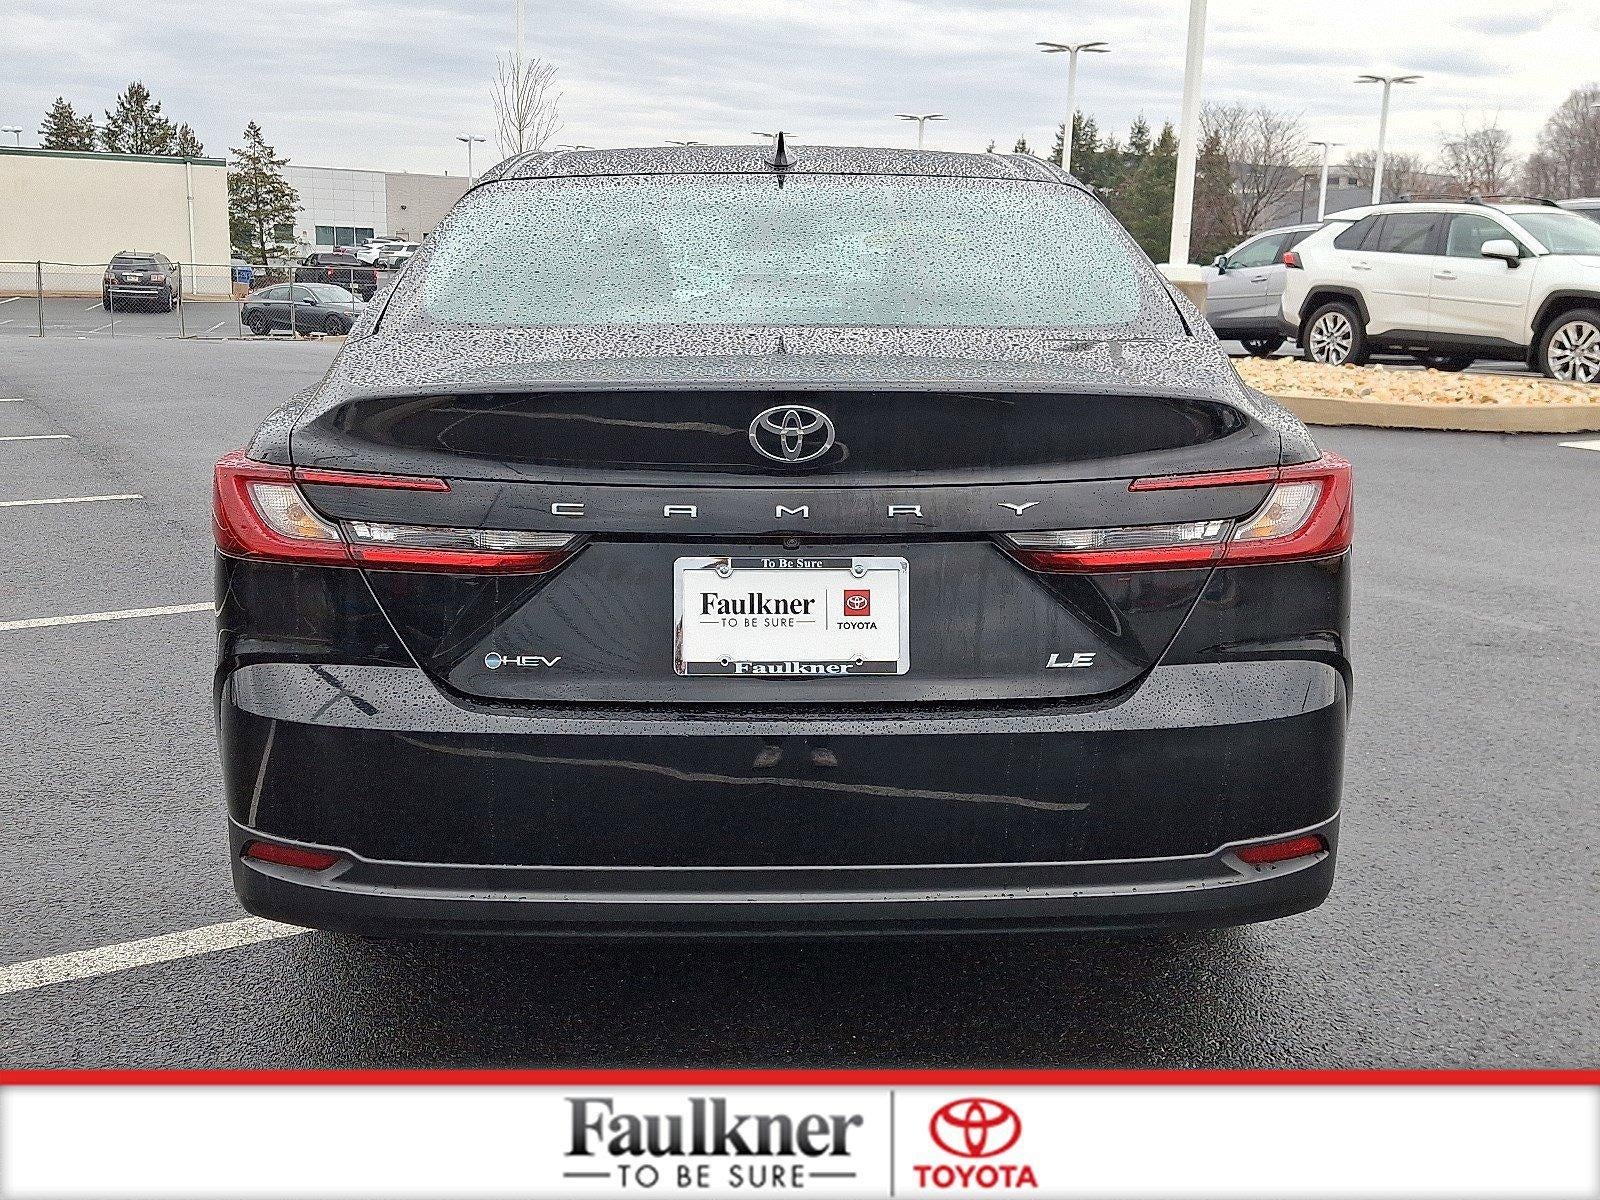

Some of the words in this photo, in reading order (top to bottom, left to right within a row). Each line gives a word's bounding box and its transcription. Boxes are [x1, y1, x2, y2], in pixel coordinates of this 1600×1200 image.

[550, 500, 1040, 518] CAMRY
[761, 558, 775, 569] To
[779, 558, 794, 569] Be
[796, 558, 824, 569] Sure
[700, 592, 816, 615] Faulkner
[721, 618, 738, 628] TO
[744, 618, 758, 628] BE
[764, 617, 795, 628] SURE
[837, 621, 878, 630] TOYOTA
[501, 655, 562, 667] HEV
[1045, 652, 1097, 669] LE
[733, 661, 854, 675] Faulkner
